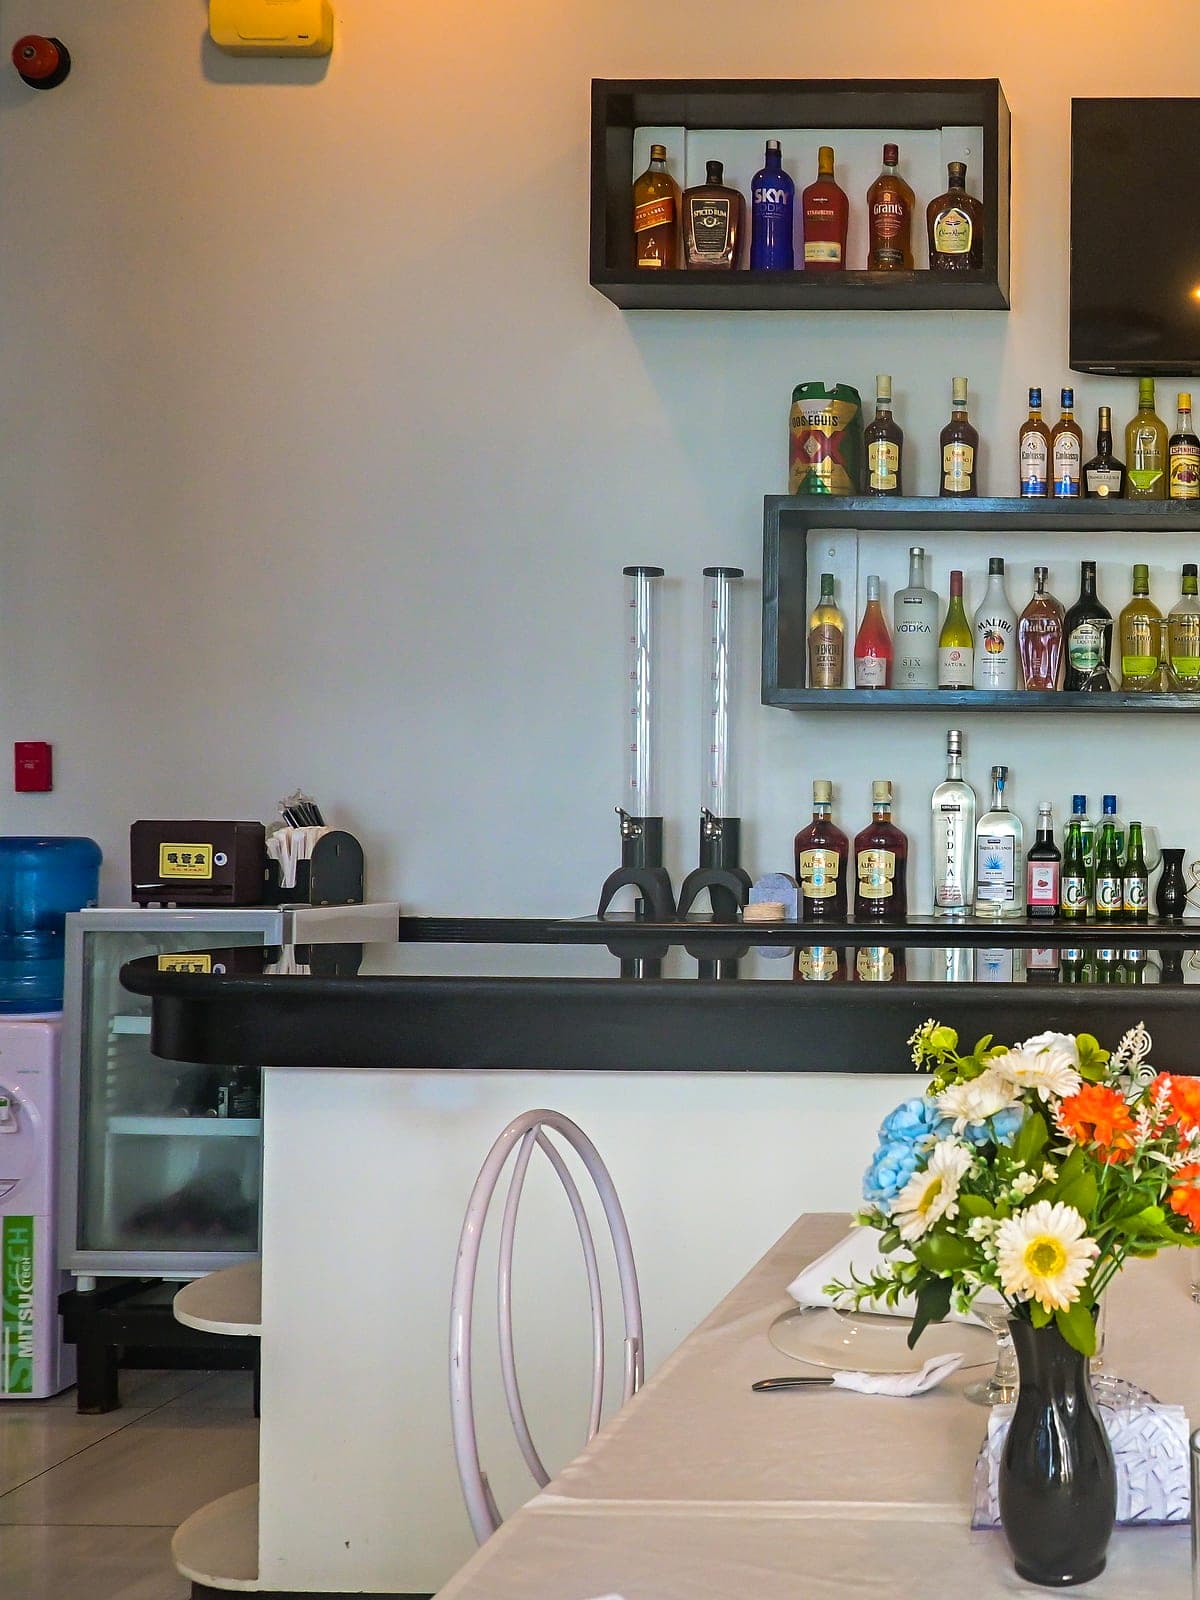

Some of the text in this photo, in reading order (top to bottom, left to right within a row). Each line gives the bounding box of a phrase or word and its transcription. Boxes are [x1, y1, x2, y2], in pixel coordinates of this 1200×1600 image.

[755, 188, 787, 205] SKYY
[896, 624, 931, 633] VODKA
[977, 618, 1013, 634] MALIBU
[902, 658, 921, 667] SIX
[945, 816, 955, 877] VODKA
[18, 1292, 34, 1358] MITSU
